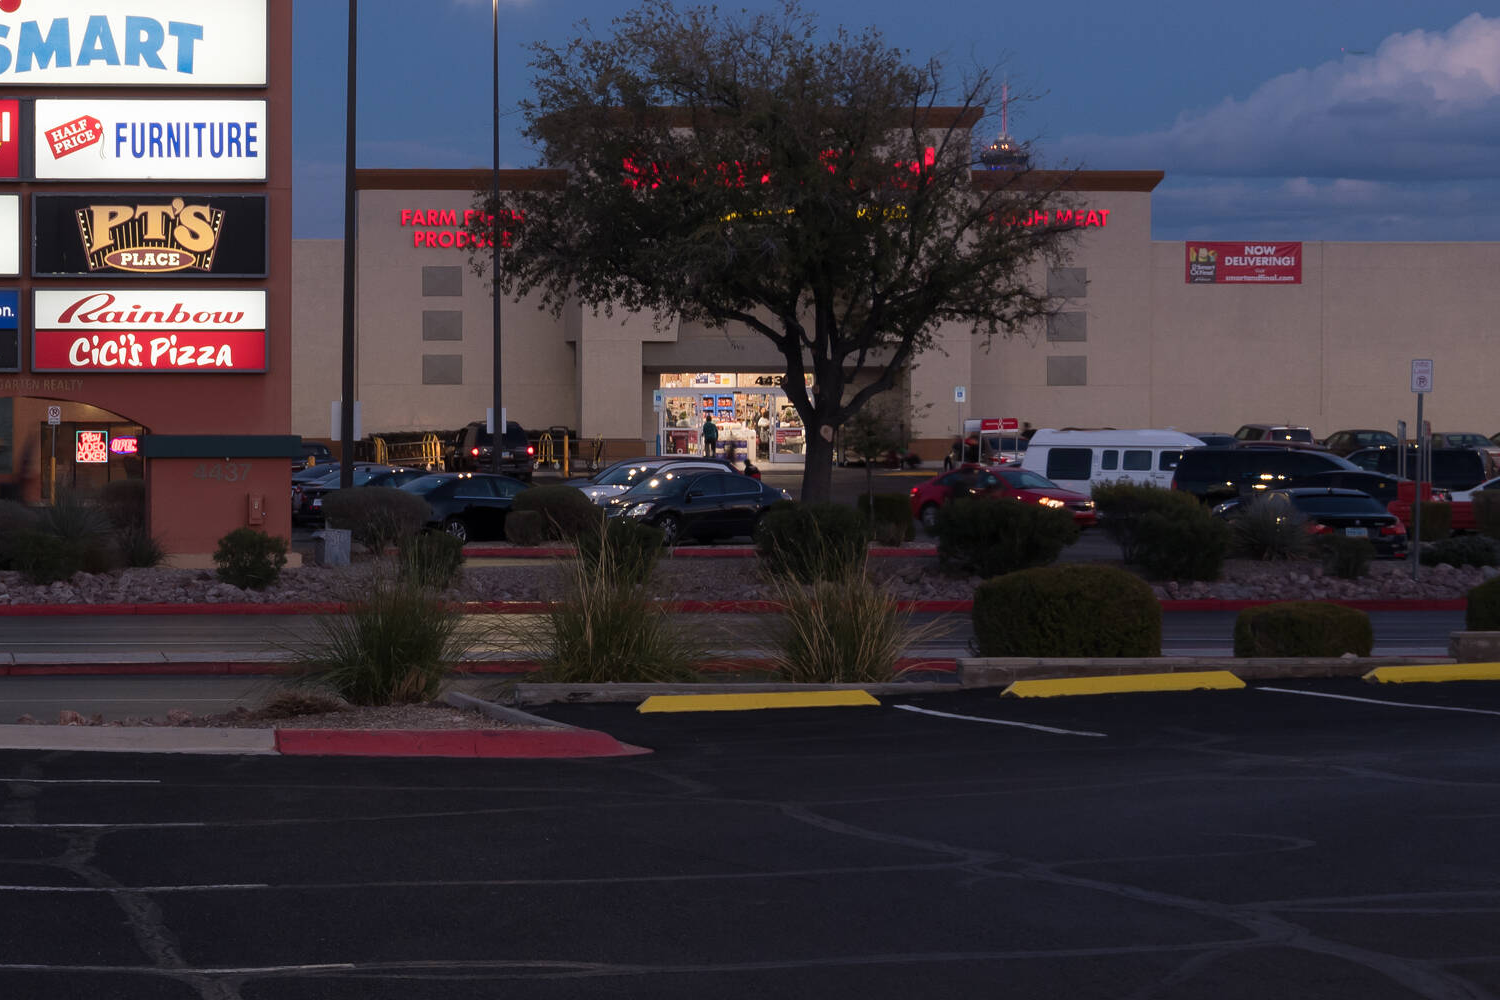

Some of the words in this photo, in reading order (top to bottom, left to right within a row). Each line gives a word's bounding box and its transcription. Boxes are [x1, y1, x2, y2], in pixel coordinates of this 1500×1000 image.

[51, 119, 87, 142] HALF
[53, 129, 96, 155] PRICE
[115, 122, 258, 158] FURNITURE
[90, 197, 216, 253] PT'S
[401, 209, 457, 226] FARM
[1056, 209, 1110, 227] MEAT
[120, 252, 180, 266] PLACE
[1244, 246, 1276, 255] NOW
[1225, 256, 1295, 266] DELIVERING!
[57, 292, 245, 324] Rainbow
[149, 334, 234, 367] Pizza
[43, 378, 84, 390] REALTY
[754, 375, 788, 386] 443
[78, 441, 106, 452] VIDEO
[80, 432, 102, 444] Play
[77, 451, 107, 462] POKER
[192, 462, 253, 482] 4437
